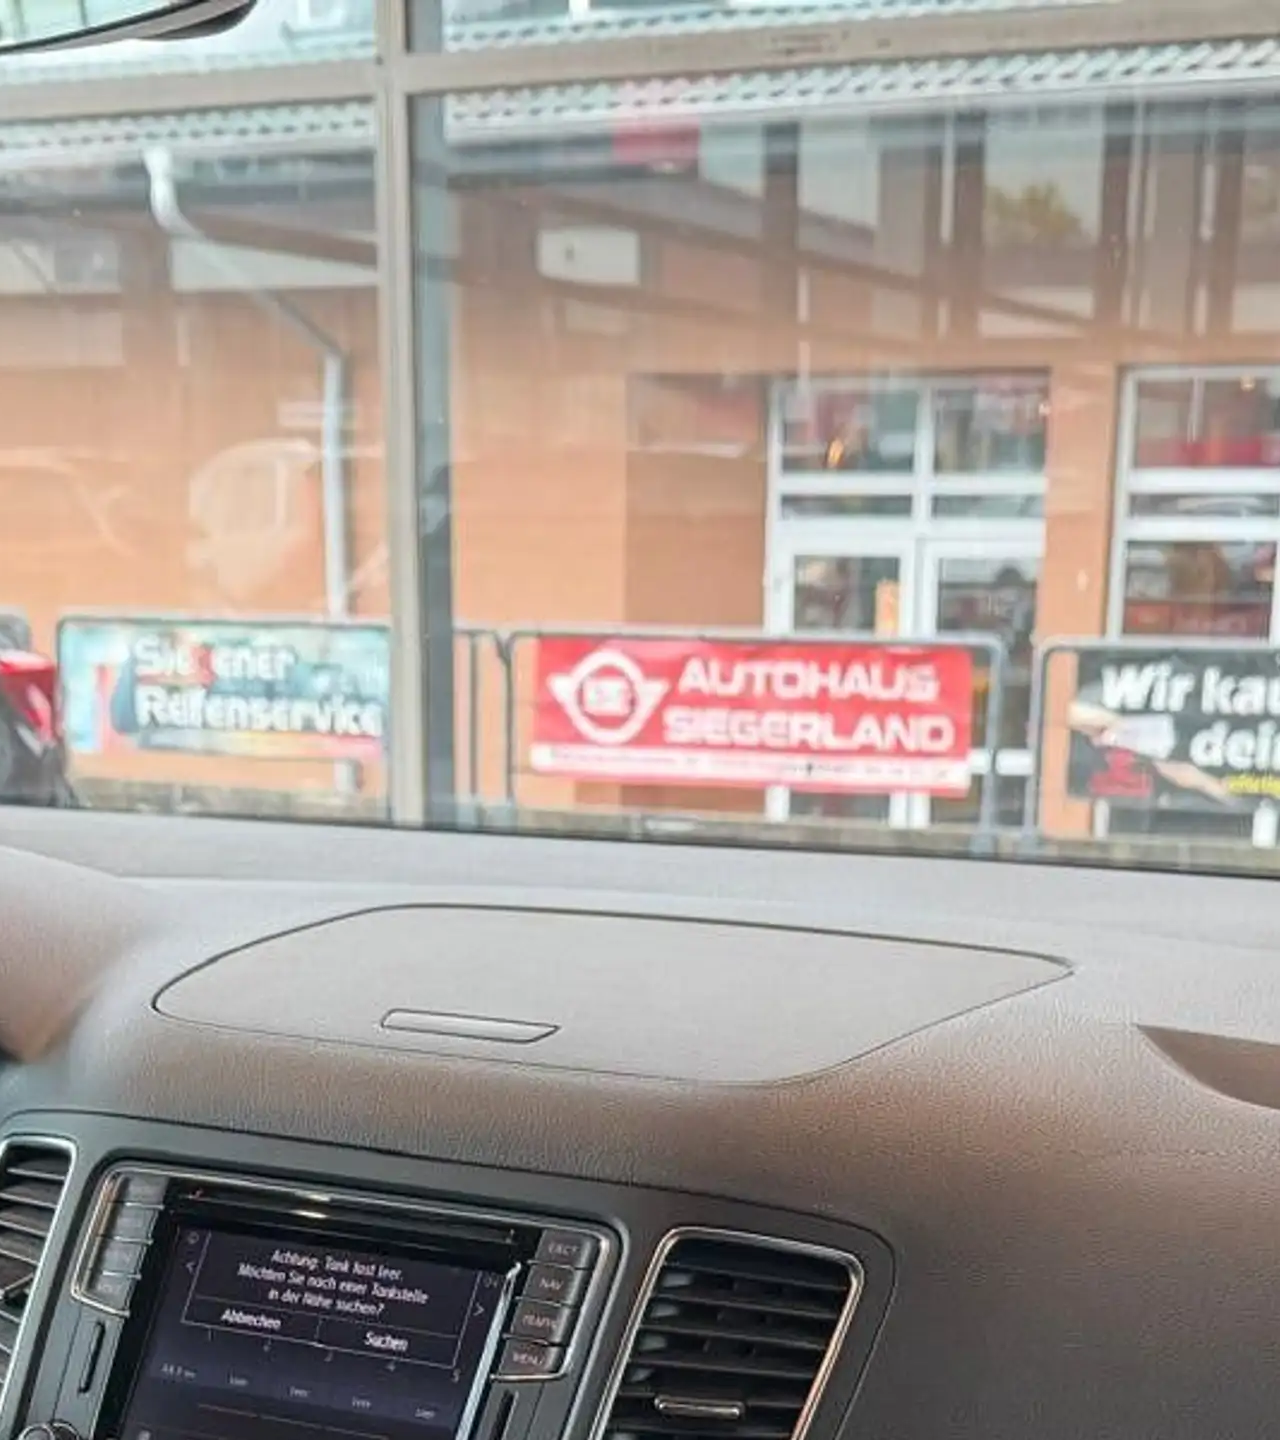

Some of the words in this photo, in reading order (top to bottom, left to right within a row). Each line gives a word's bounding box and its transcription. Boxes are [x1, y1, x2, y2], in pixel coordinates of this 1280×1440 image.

[678, 656, 940, 702] AUTOHAUS
[1100, 663, 1196, 713] Wir
[133, 683, 383, 738] Reifenservice
[662, 703, 956, 753] SIEGERLAND
[220, 1308, 283, 1332] Abbrechen
[363, 1331, 410, 1353] Suchen
